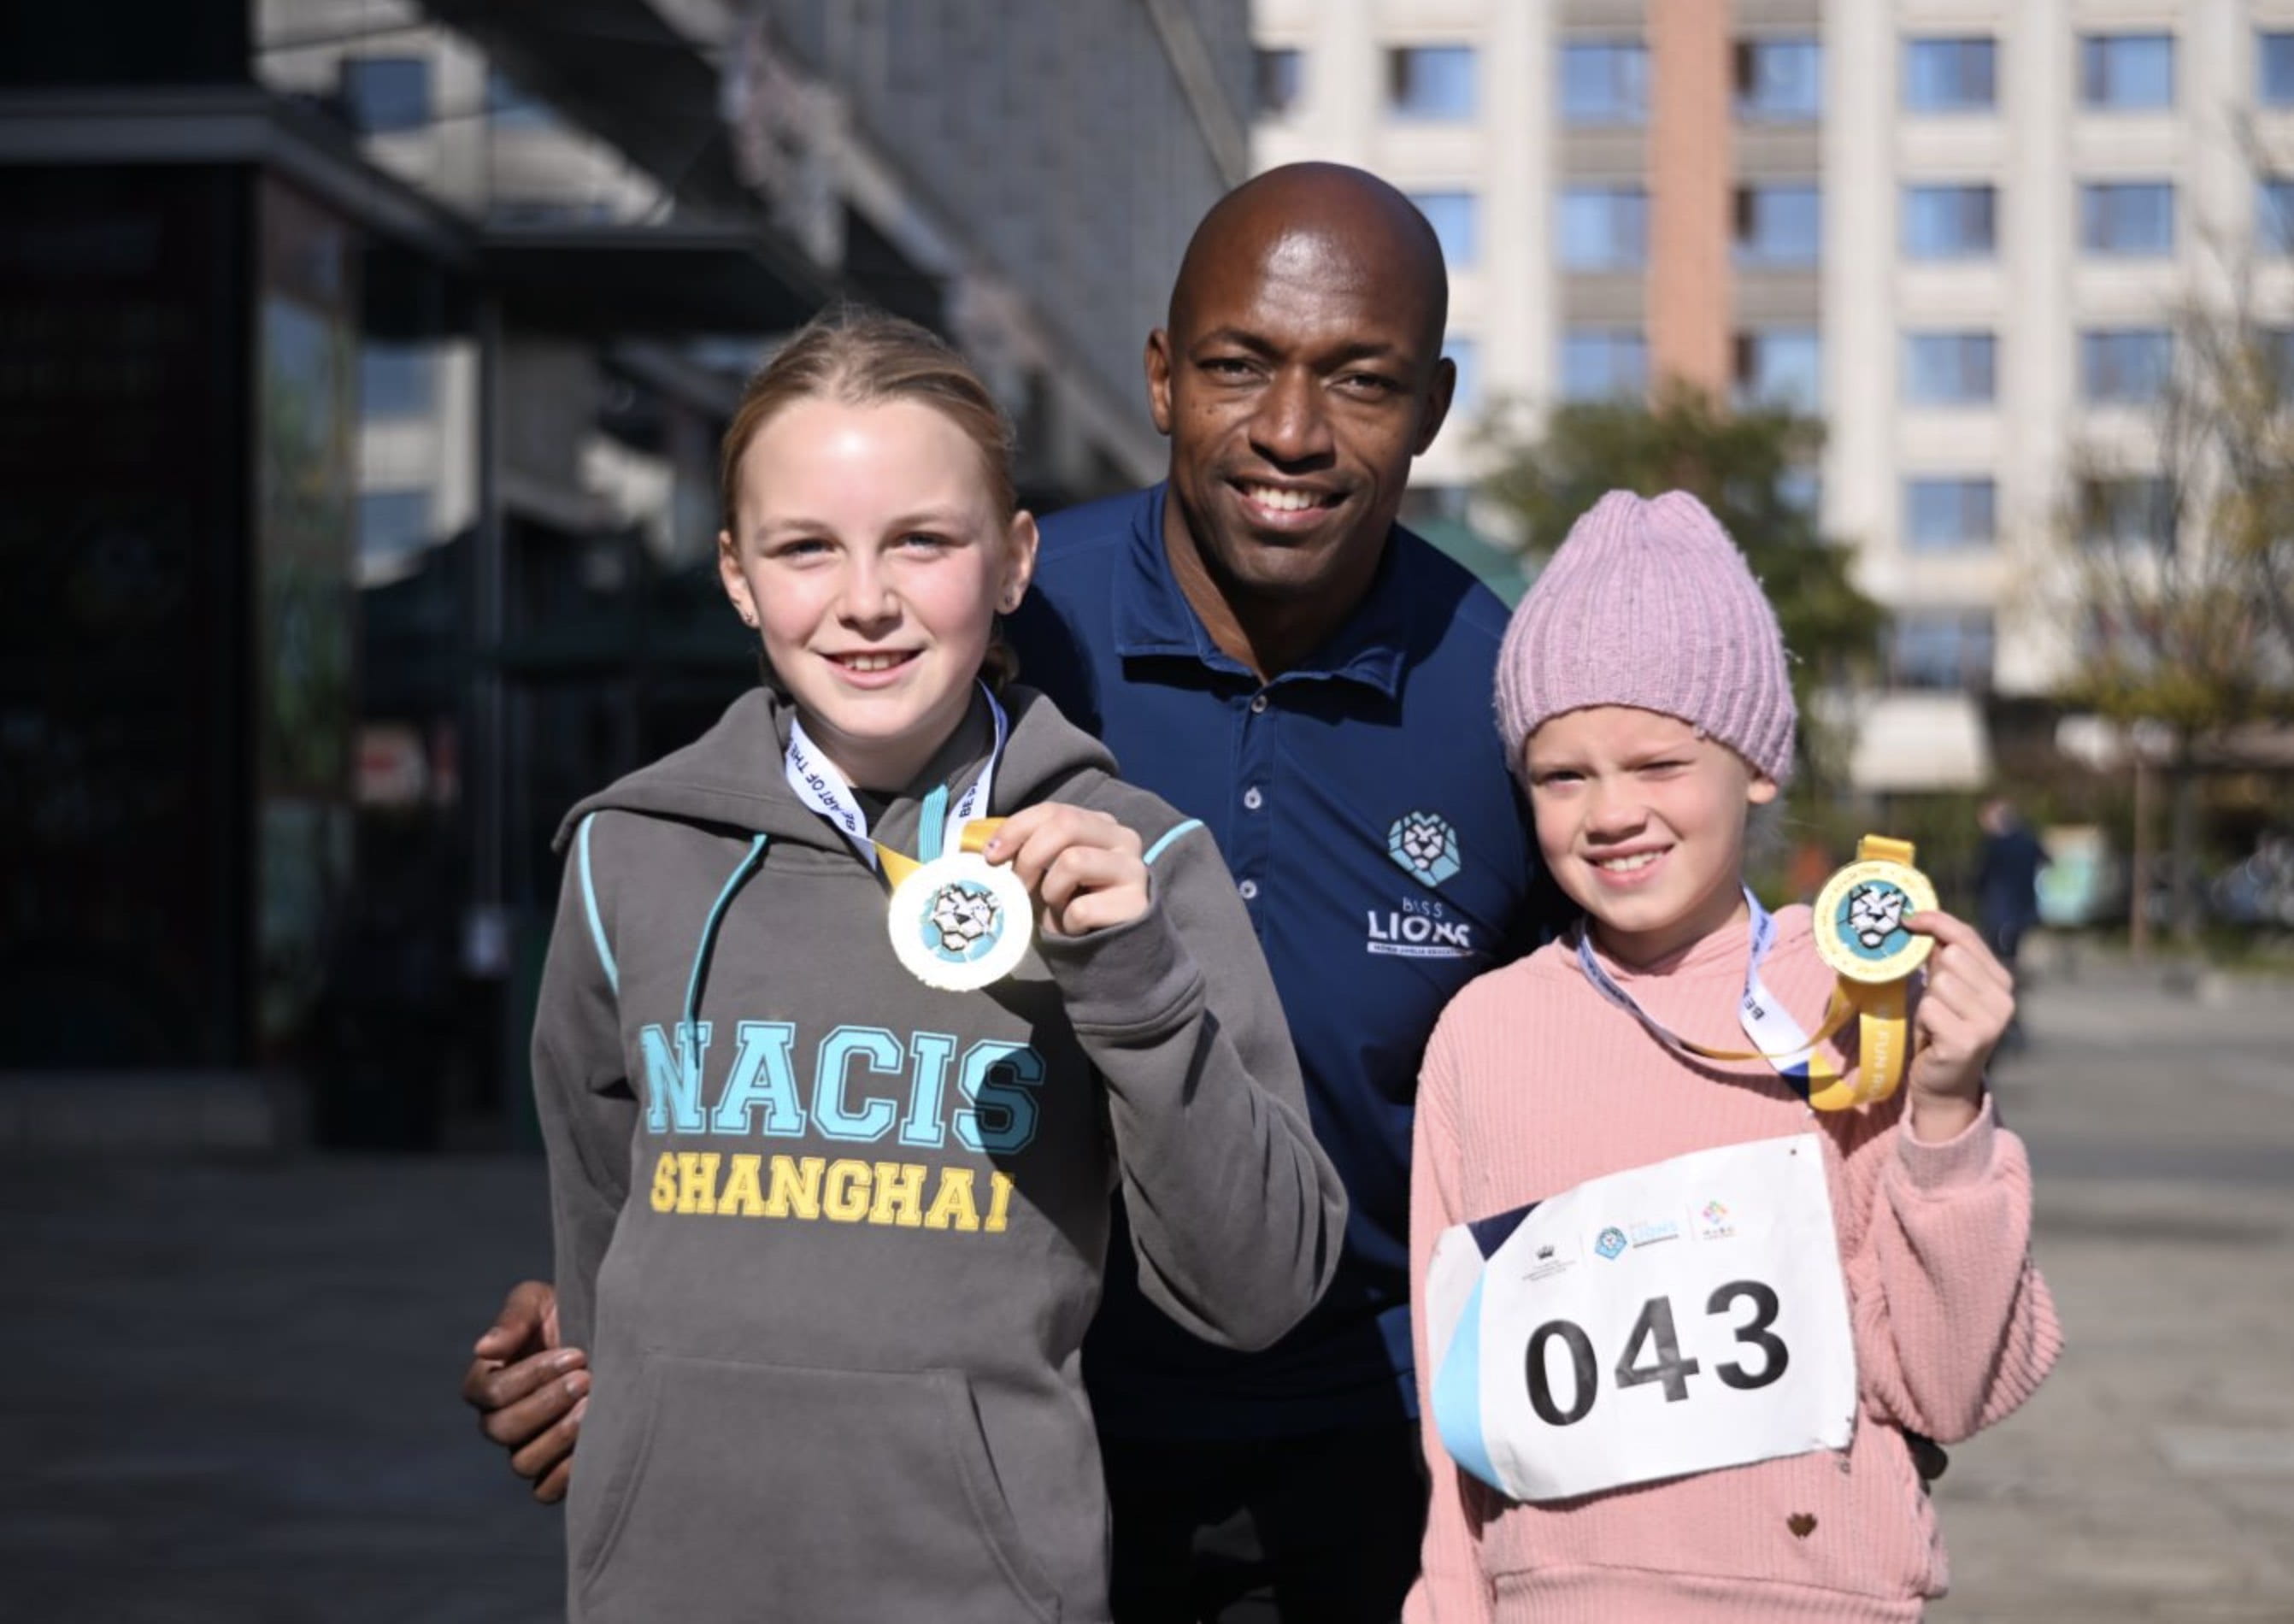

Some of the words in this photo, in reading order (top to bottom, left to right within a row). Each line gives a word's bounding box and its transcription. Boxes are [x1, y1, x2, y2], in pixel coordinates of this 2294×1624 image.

[805, 772, 826, 791] OF
[818, 791, 844, 812] ART
[640, 1020, 1046, 1155] NACIS
[650, 1151, 1015, 1233] SHANGHAI
[1525, 1280, 1790, 1427] 043
